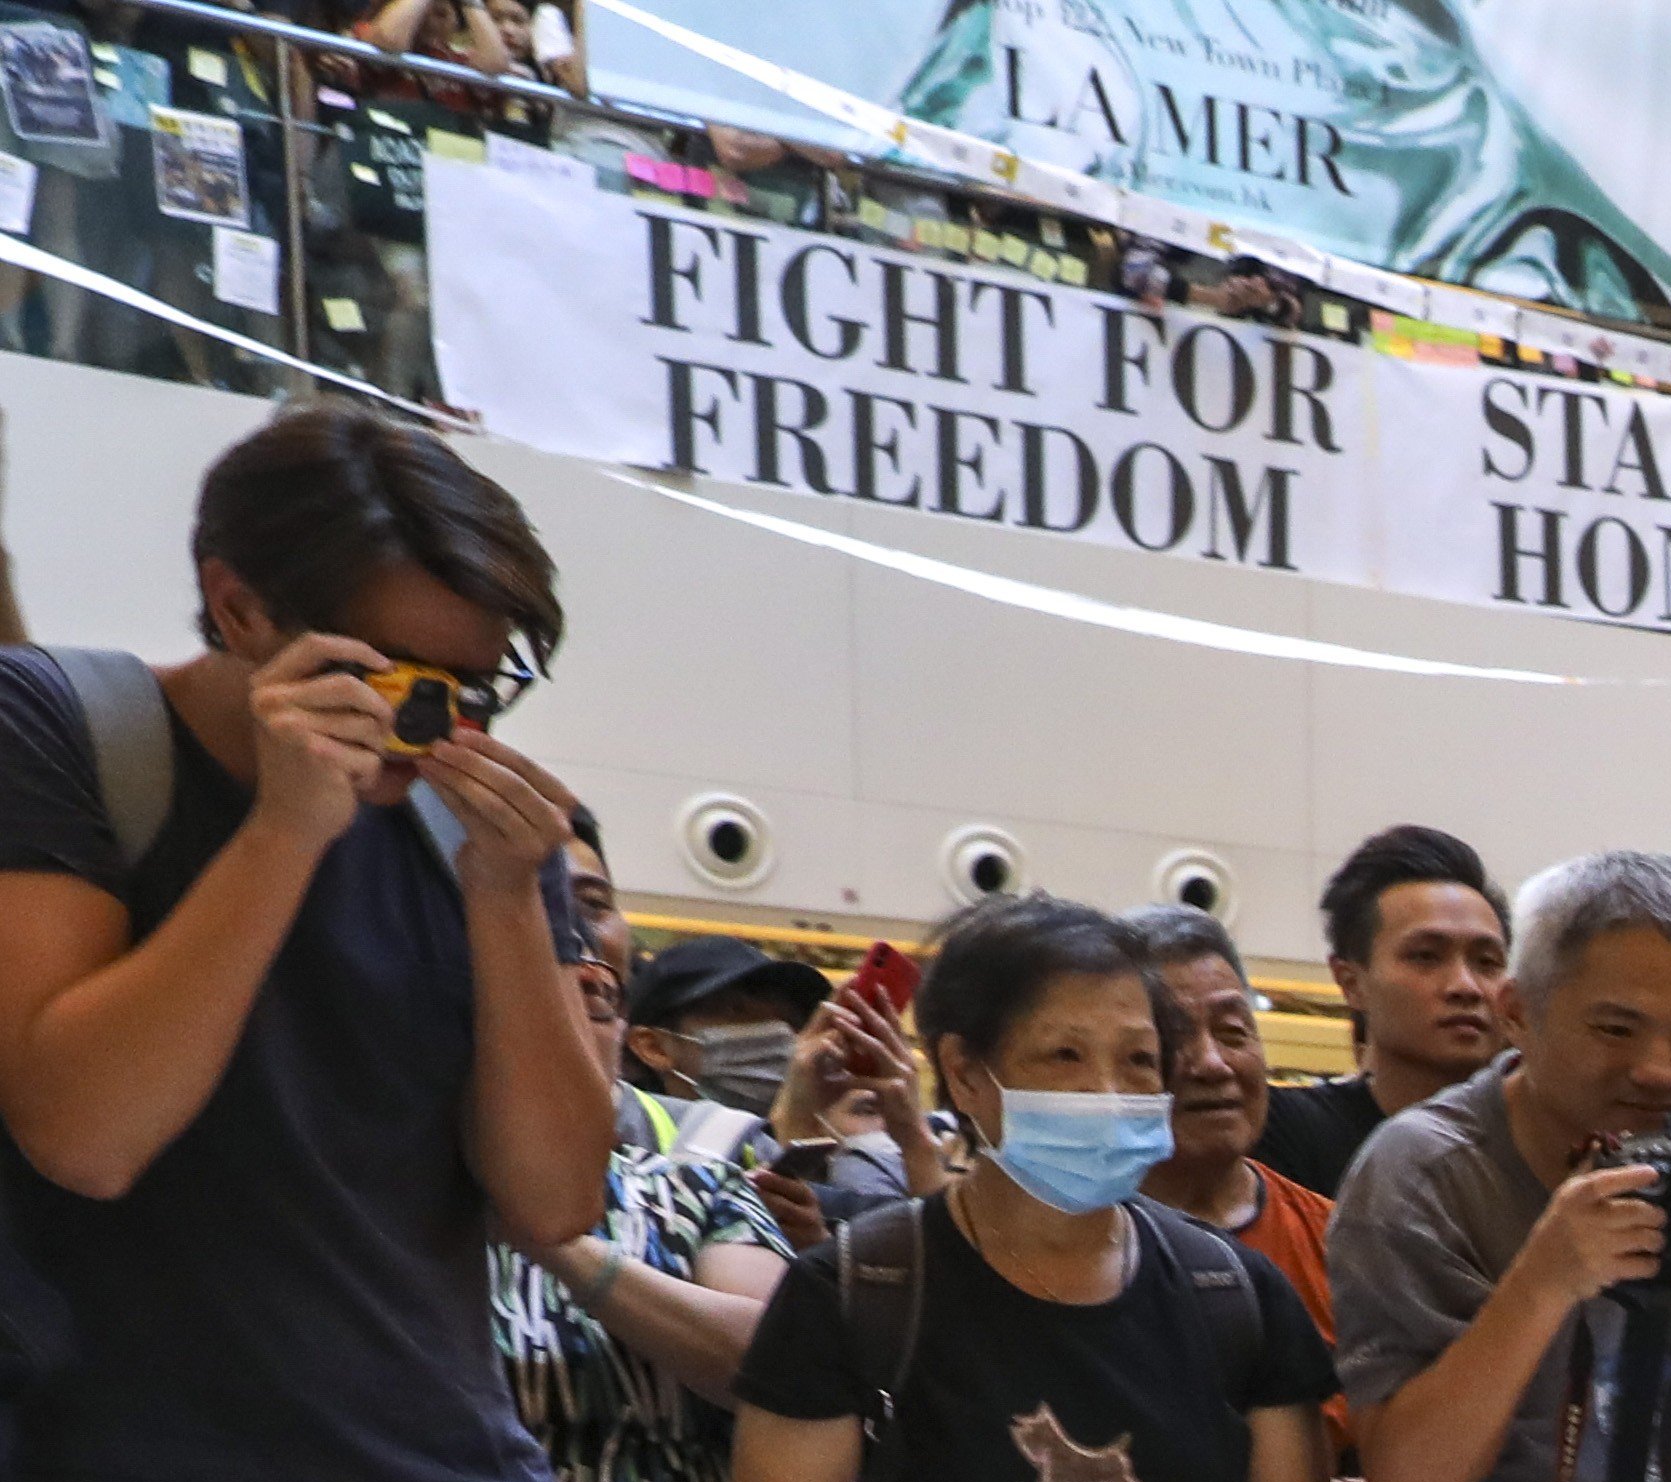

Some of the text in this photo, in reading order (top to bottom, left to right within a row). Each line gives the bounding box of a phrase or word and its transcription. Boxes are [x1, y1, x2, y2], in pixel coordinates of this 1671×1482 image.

[1202, 32, 1284, 80] Town
[635, 209, 1347, 456] FIGHT FOR
[653, 355, 1301, 574] FREEDOM
